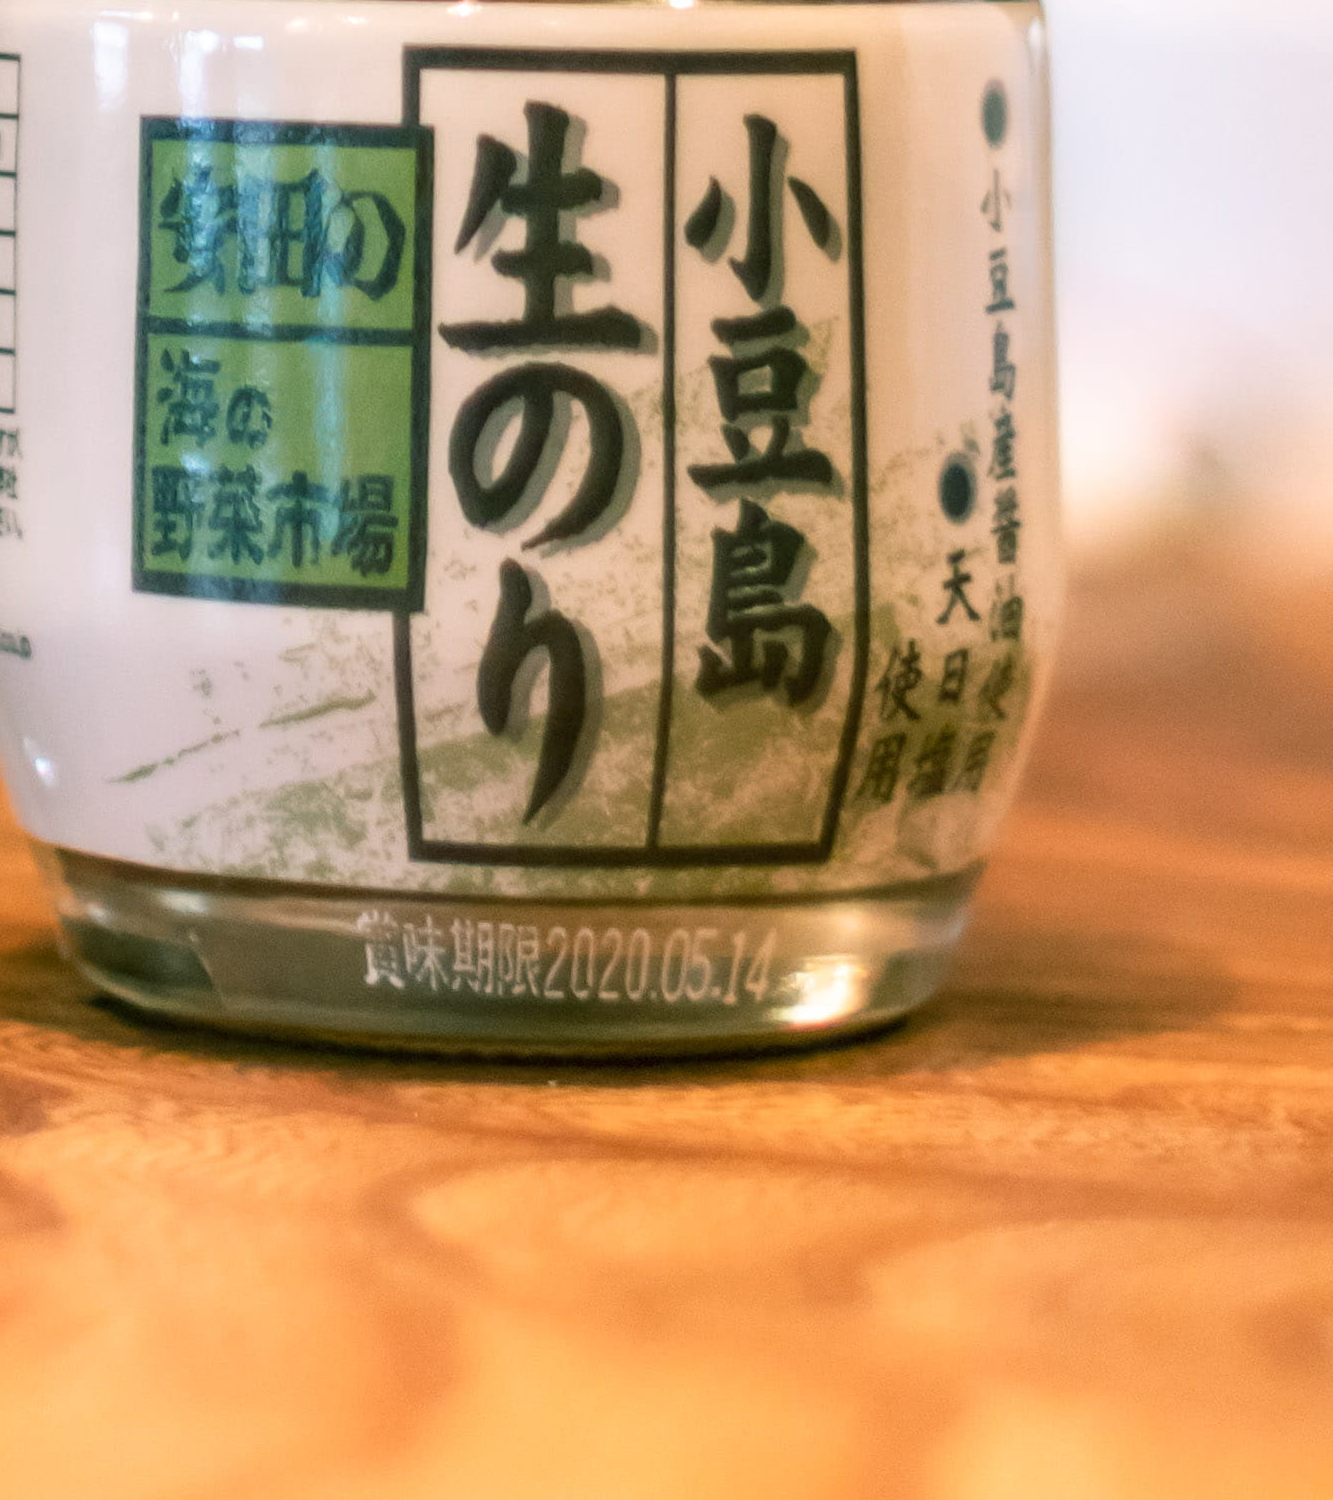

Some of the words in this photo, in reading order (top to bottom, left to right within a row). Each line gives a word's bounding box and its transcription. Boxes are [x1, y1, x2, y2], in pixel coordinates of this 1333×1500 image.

[150, 462, 399, 577] 野菜市場
[155, 346, 273, 449] 海の
[438, 100, 651, 827] 生のり
[685, 112, 839, 703] 小豆島
